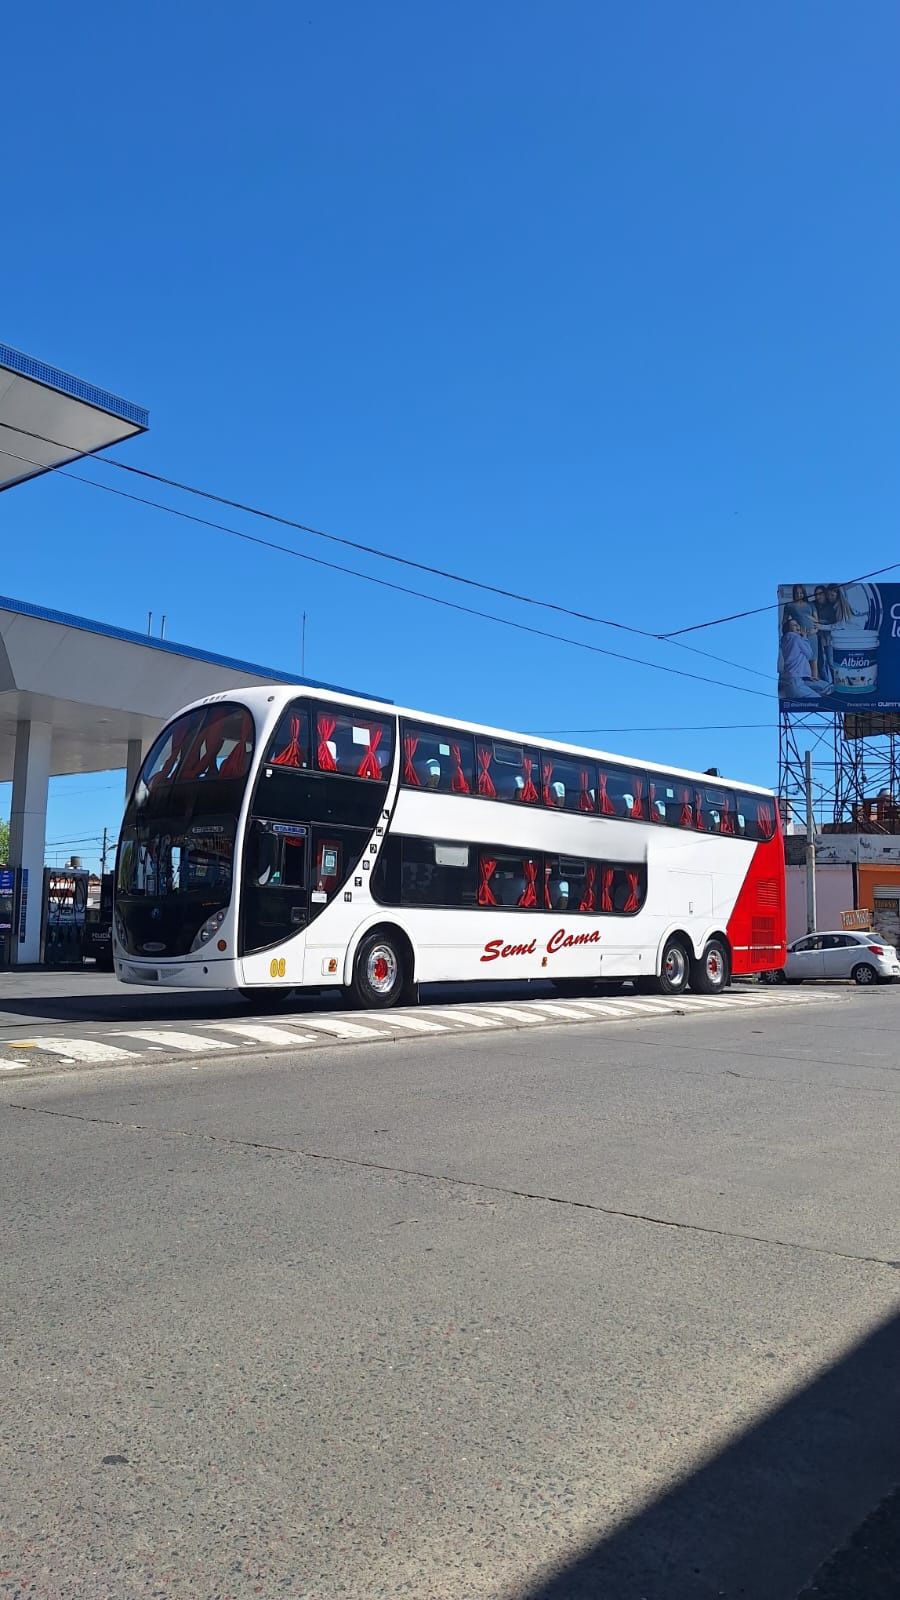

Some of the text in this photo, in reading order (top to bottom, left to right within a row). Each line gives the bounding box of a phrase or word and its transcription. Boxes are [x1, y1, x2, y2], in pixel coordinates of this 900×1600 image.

[840, 655, 870, 668] Albión
[480, 928, 601, 962] Semi Cama
